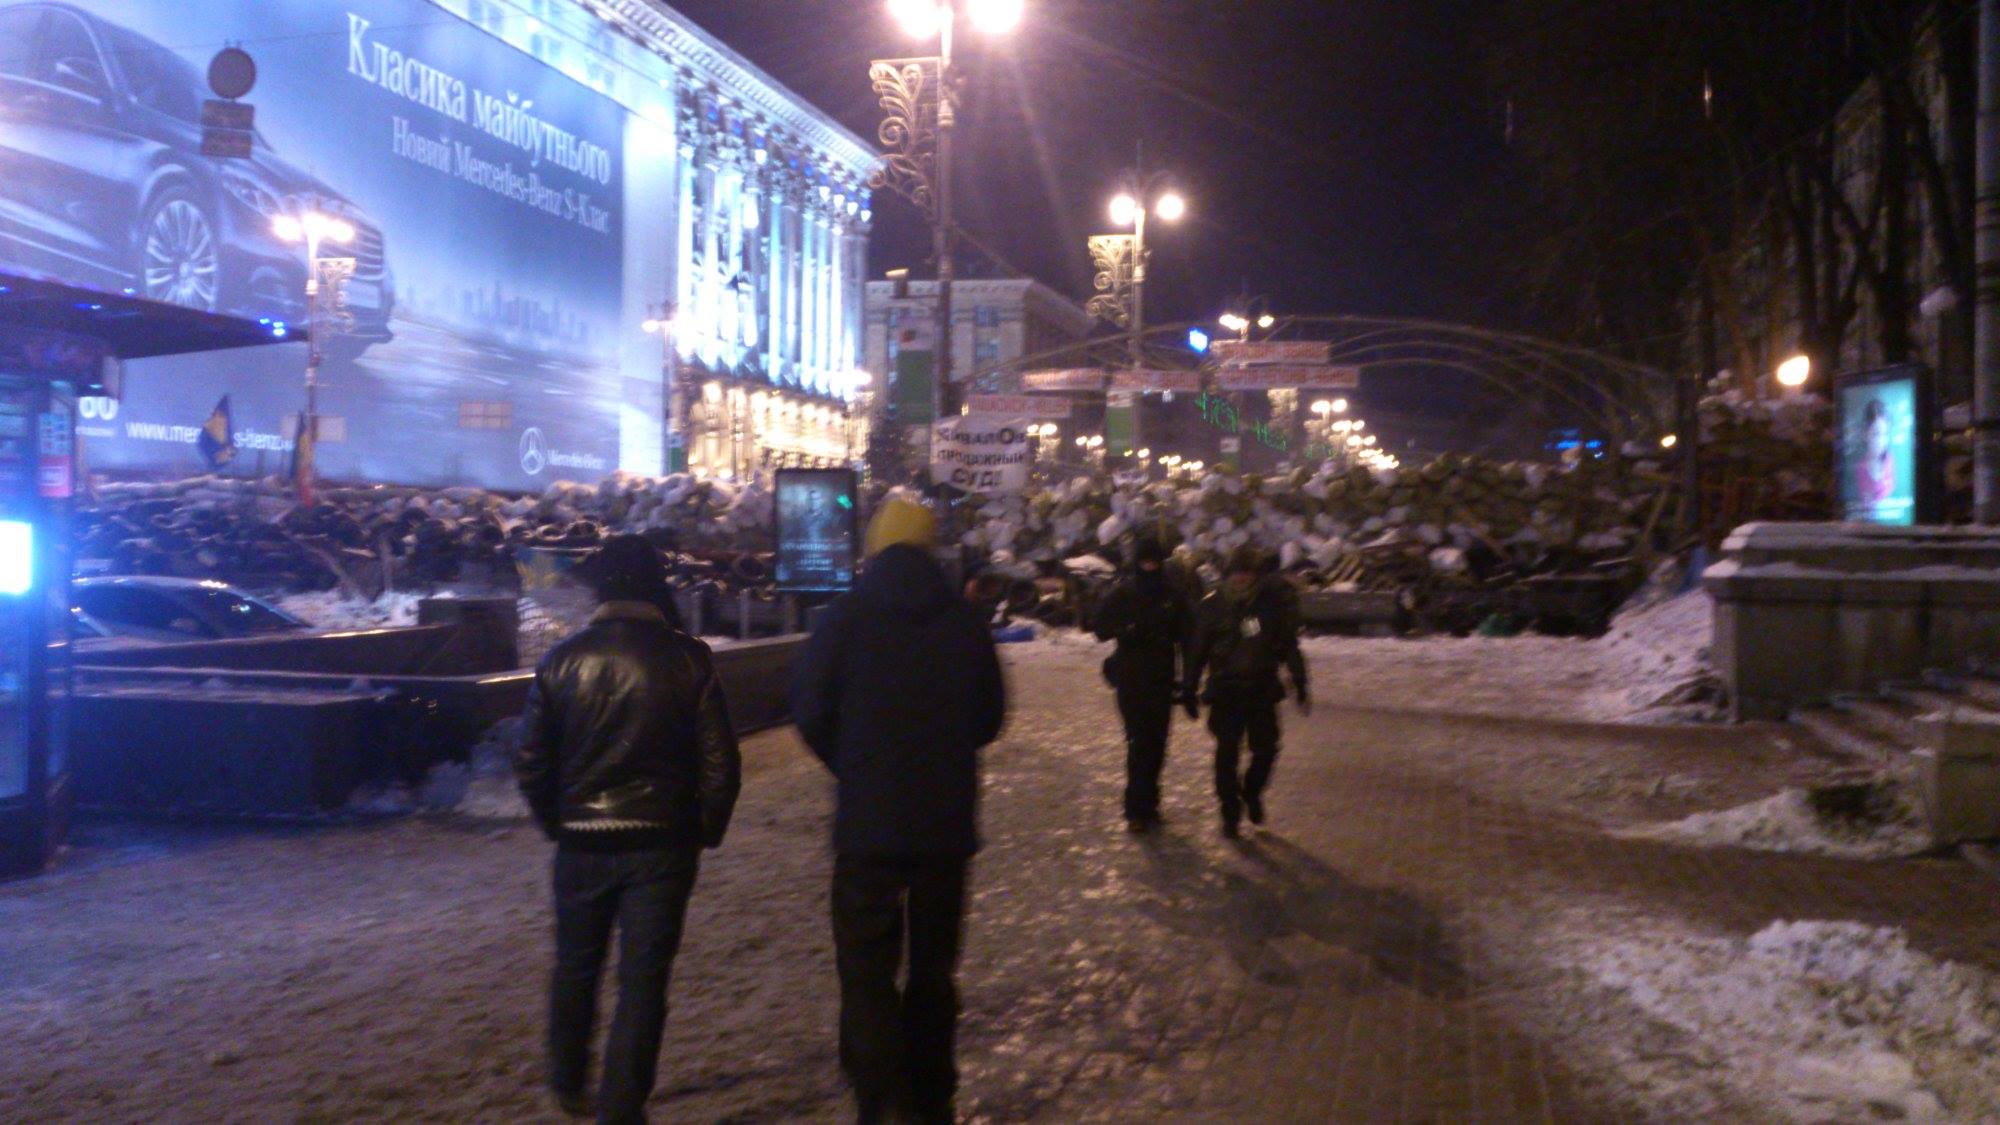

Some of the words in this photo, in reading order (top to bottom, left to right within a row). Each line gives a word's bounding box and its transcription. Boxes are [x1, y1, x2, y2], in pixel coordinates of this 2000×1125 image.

[347, 12, 467, 123] Класика
[472, 89, 611, 185] майбутнього
[392, 115, 450, 174] Новий
